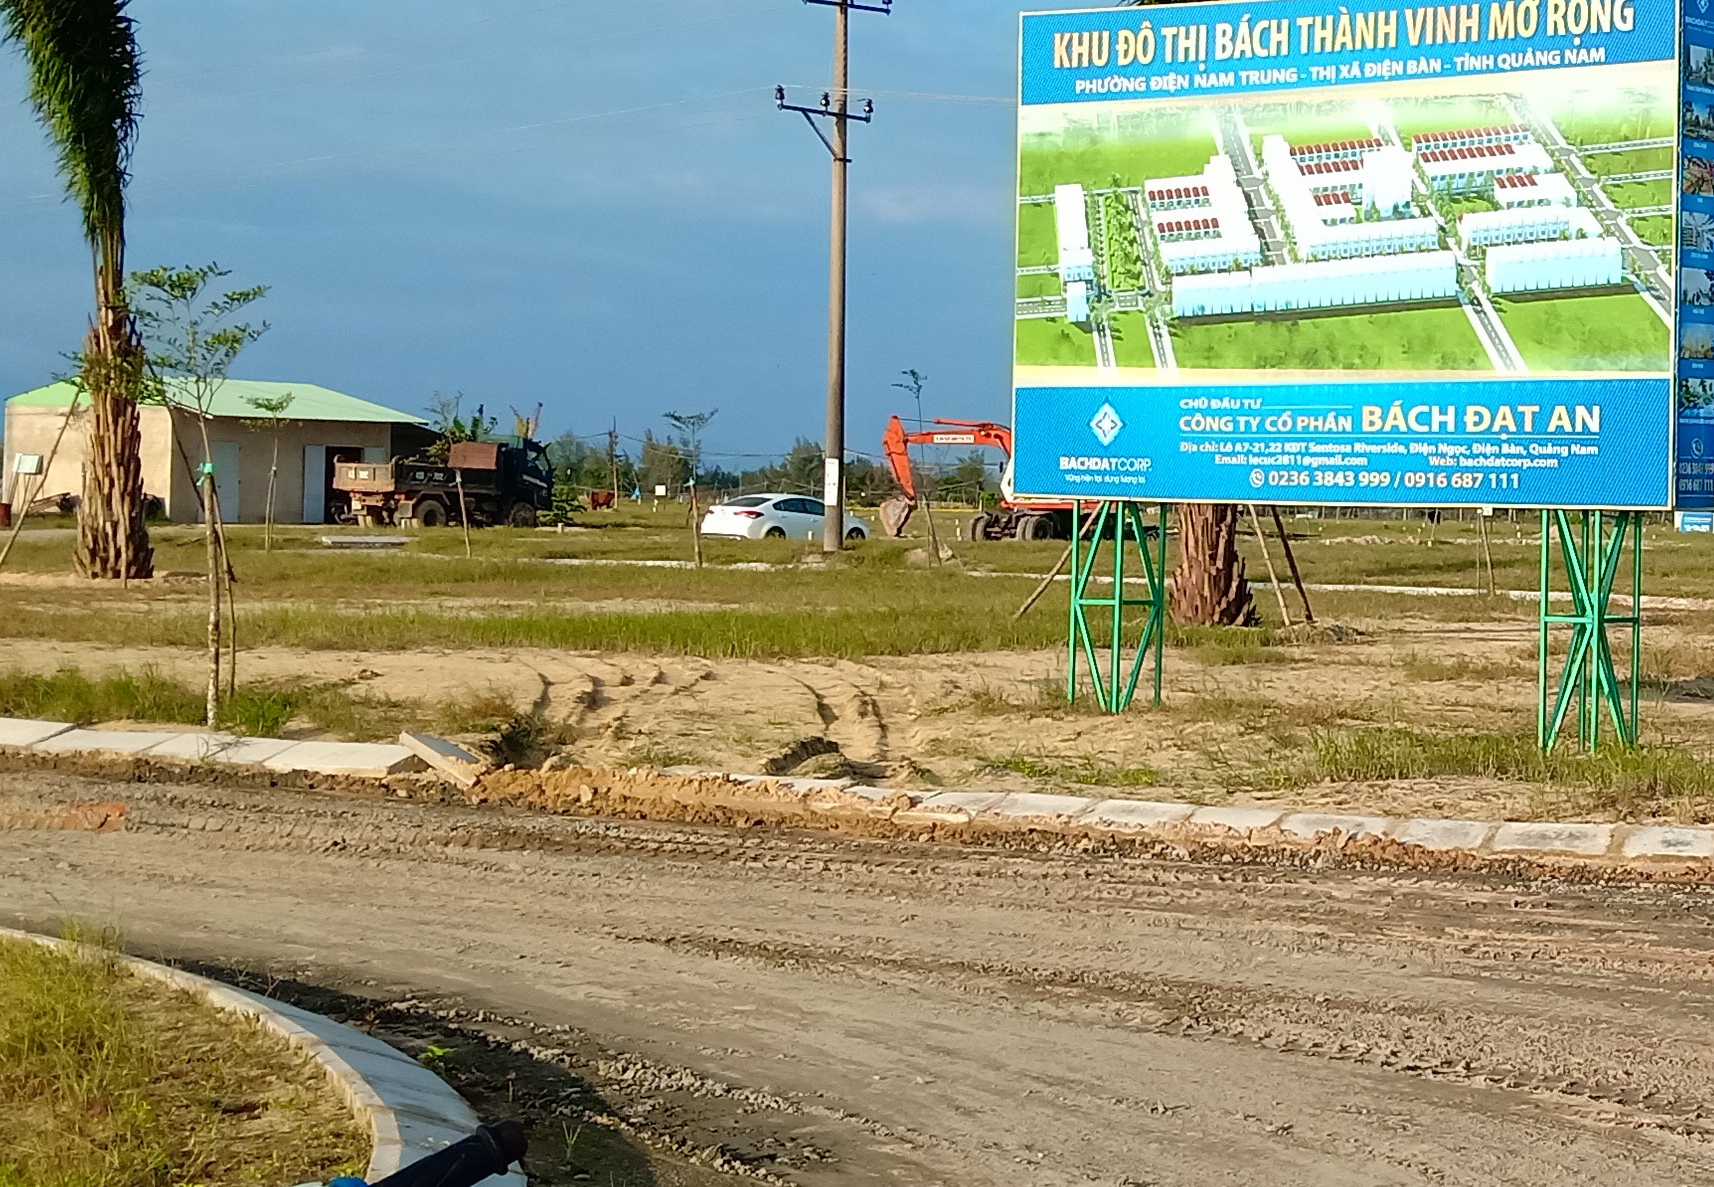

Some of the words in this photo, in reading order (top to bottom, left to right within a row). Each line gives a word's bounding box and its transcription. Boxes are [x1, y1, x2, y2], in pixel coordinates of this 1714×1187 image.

[1053, 30, 1110, 69] KHU
[1116, 20, 1156, 66] ĐÔ
[1161, 24, 1208, 72] THỊ
[1215, 12, 1290, 61] BÁCH
[1296, 5, 1398, 56] THÀNH
[1404, 2, 1480, 46] VINH
[1075, 73, 1147, 94] PHƯỜNG
[1150, 70, 1190, 94] ĐIỆN
[1194, 71, 1235, 88] NAM
[1239, 67, 1298, 86] TRUNG
[1308, 65, 1337, 85] THỊ
[1339, 60, 1362, 80] XÃ
[1364, 58, 1404, 82] ĐIỆN
[1406, 56, 1442, 76] BÀN
[1453, 50, 1499, 73] TỈNH
[1500, 46, 1562, 71] QUẢNG
[1563, 45, 1606, 65] NAM
[1179, 412, 1234, 432] CÔNG
[1236, 416, 1262, 433] TY
[1361, 399, 1456, 433] BÁCH
[1463, 405, 1540, 440] ĐẠT
[1546, 405, 1600, 433] AN
[1570, 443, 1599, 455] Nam
[1214, 454, 1248, 466] Email:
[1428, 456, 1458, 467] Web:
[1459, 455, 1559, 470] bachdatcorp.com
[1268, 471, 1310, 486] 0236
[1312, 471, 1355, 487] 3843
[1358, 471, 1391, 487] 999
[1404, 472, 1448, 488] 0916
[1451, 472, 1483, 488] 687
[1488, 473, 1519, 489] 111
